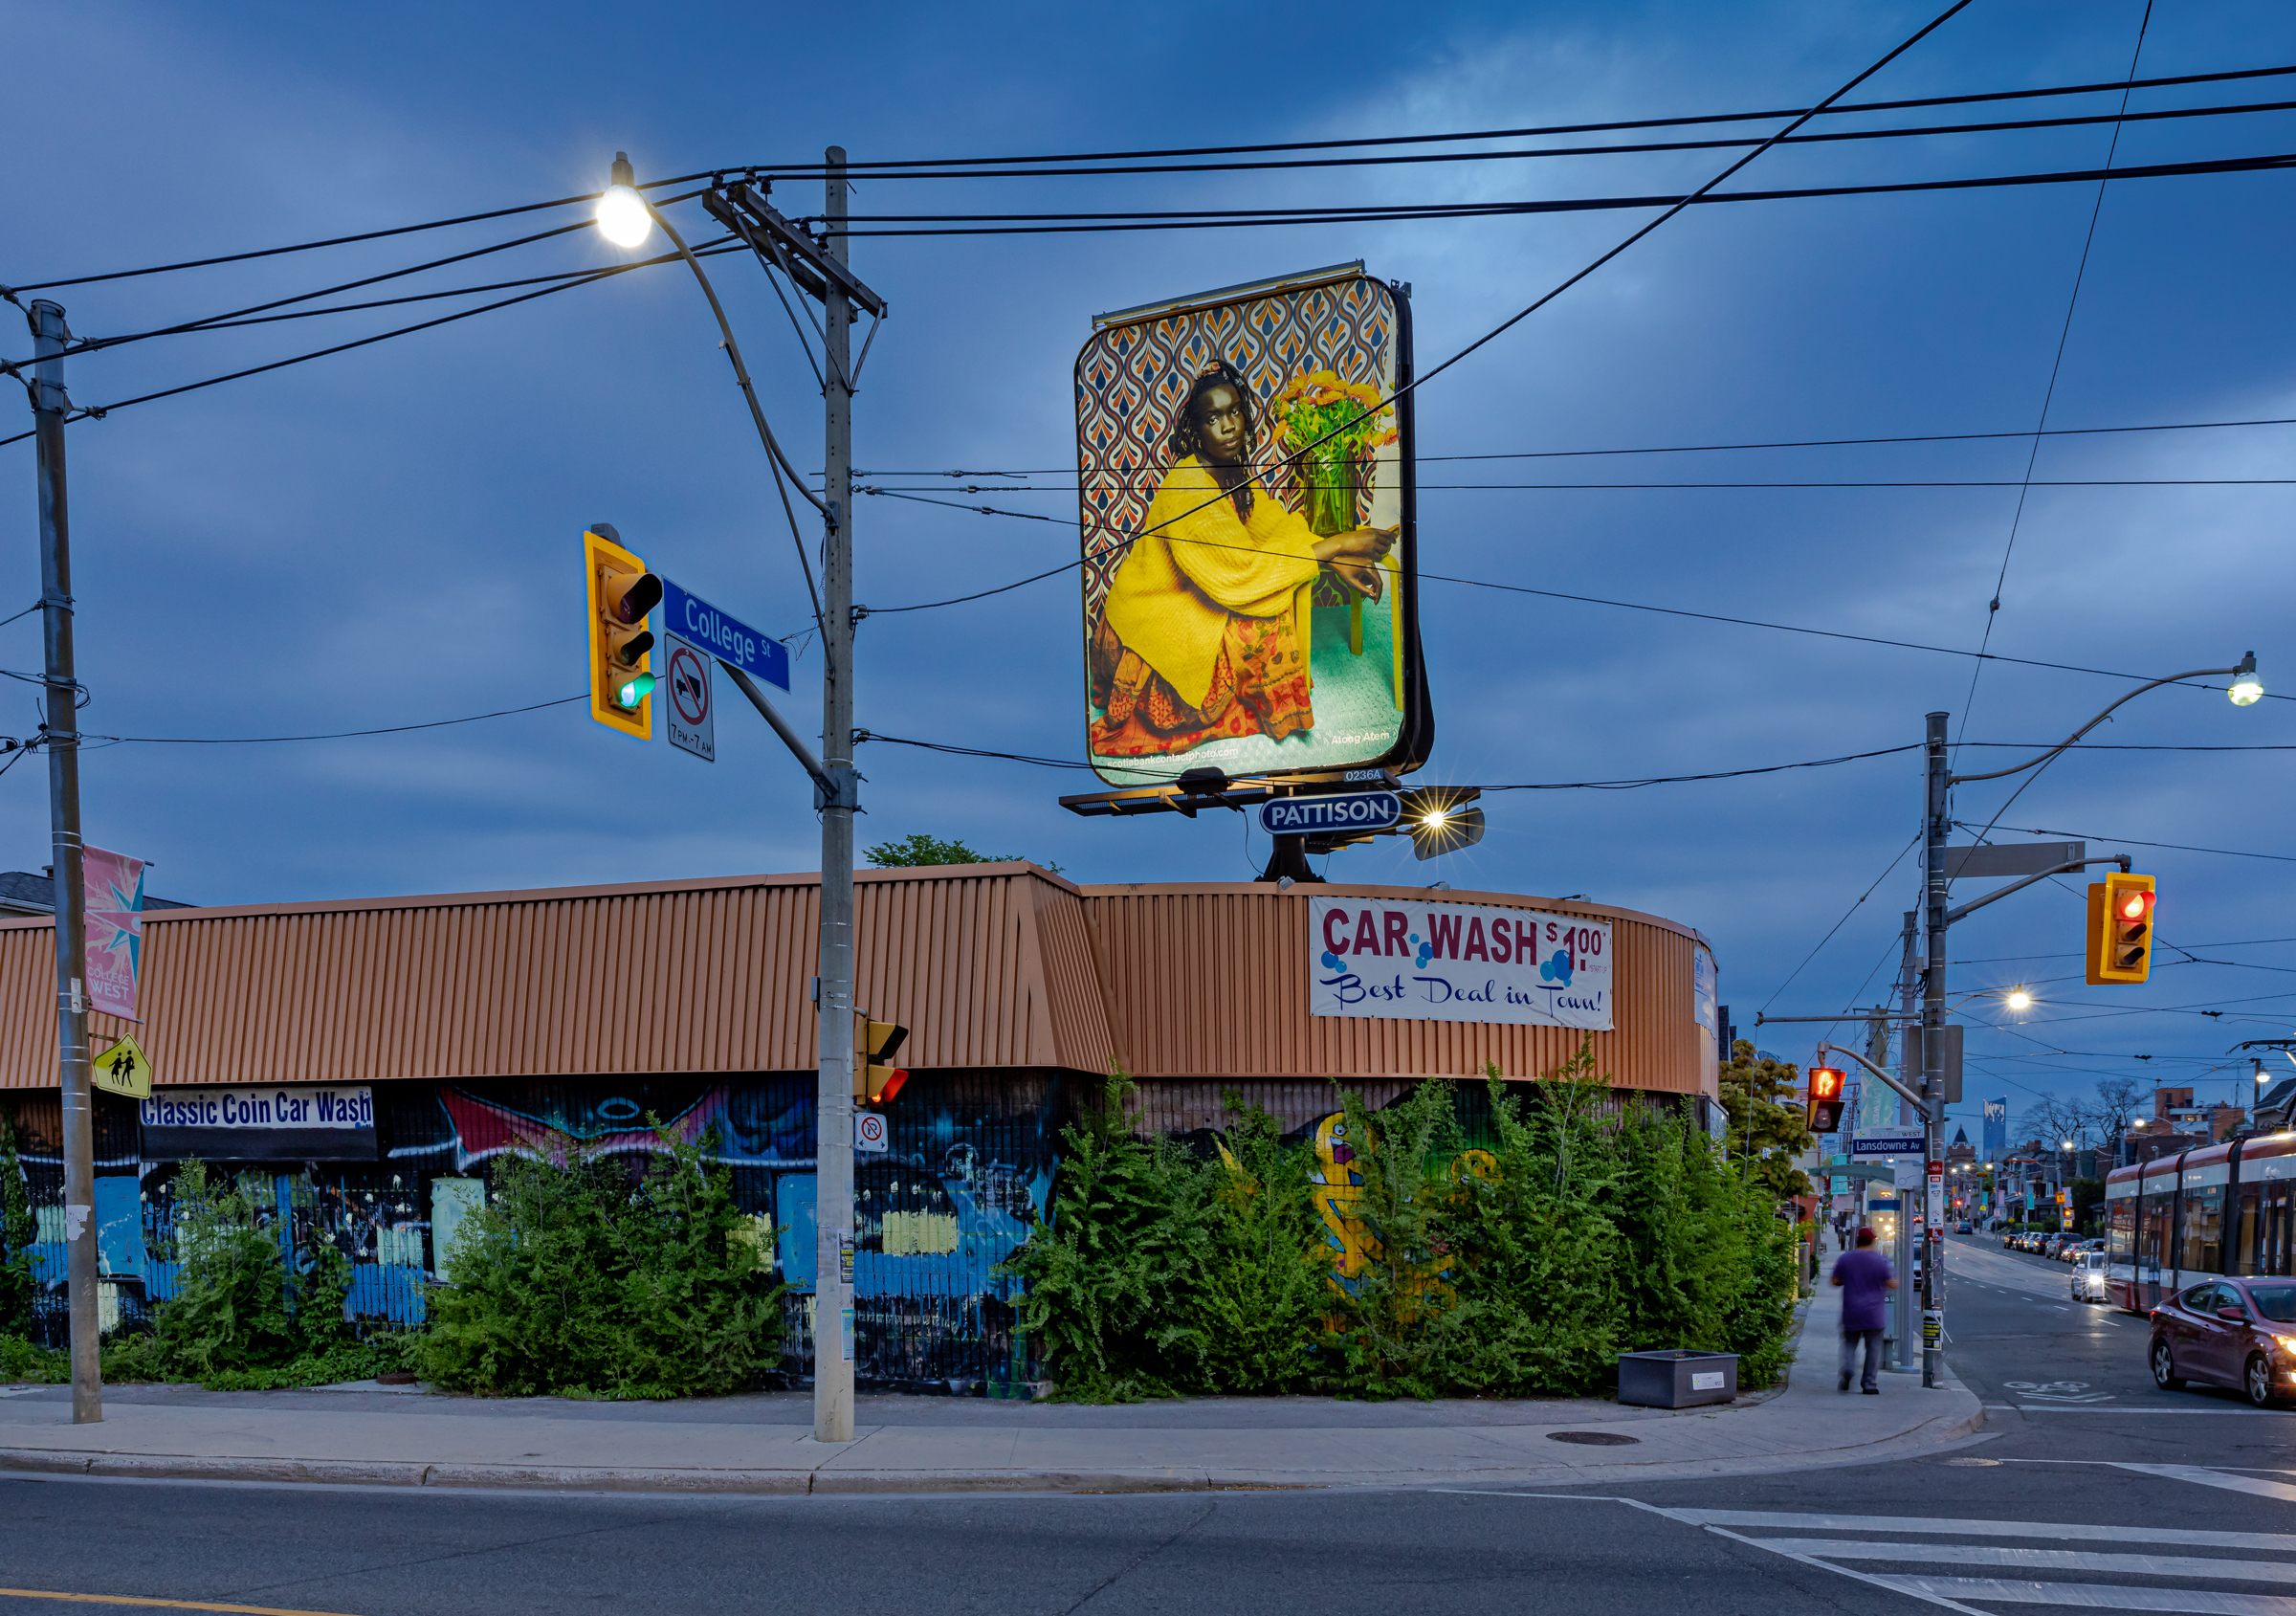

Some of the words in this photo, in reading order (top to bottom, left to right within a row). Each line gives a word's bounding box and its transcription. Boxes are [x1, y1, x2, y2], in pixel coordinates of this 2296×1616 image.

[685, 598, 756, 666] College
[761, 639, 771, 658] St
[1331, 734, 1361, 745] Atong
[1363, 731, 1390, 742] Atem
[1107, 747, 1239, 768] scotiabankcontactphoto.com
[1345, 769, 1381, 782] 0236A
[1271, 799, 1389, 826] PATTISON
[1322, 908, 1411, 958] CAR
[1426, 912, 1538, 966] WASH
[87, 966, 130, 985] COLLEGE
[88, 978, 129, 1001] WEST
[1318, 973, 1406, 1011] Best
[1412, 976, 1497, 1004] Deal
[1505, 985, 1534, 1005] in
[1534, 984, 1602, 1018] Town!
[142, 1094, 218, 1125] Classic
[222, 1093, 272, 1124] Coin
[276, 1091, 310, 1122] Car
[315, 1090, 372, 1122] Wash
[1856, 1140, 1908, 1151] Lansdowne
[1910, 1141, 1920, 1150] Av
